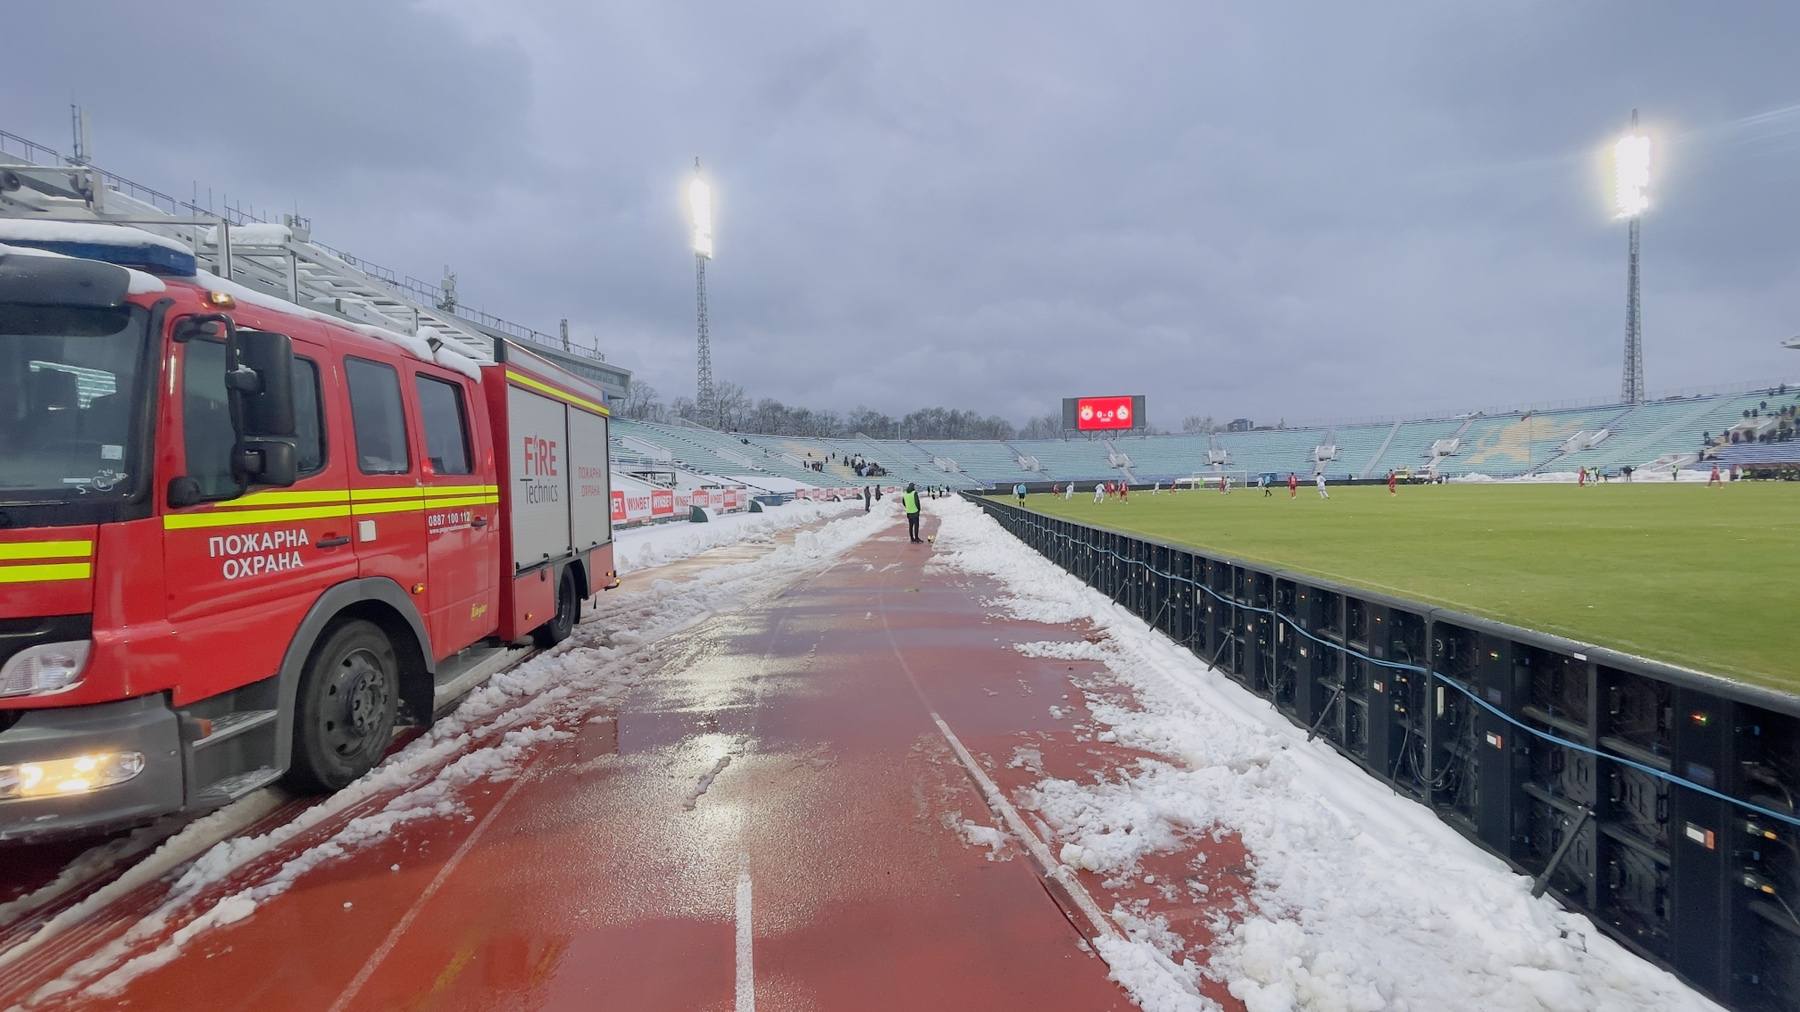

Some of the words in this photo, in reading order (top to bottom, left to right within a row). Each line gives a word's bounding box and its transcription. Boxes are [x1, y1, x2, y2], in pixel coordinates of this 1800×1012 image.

[519, 478, 558, 504] Technics
[626, 496, 651, 511] WINBET
[208, 528, 309, 558] ПОЖАРНА
[223, 551, 304, 580] ОХРАНА
